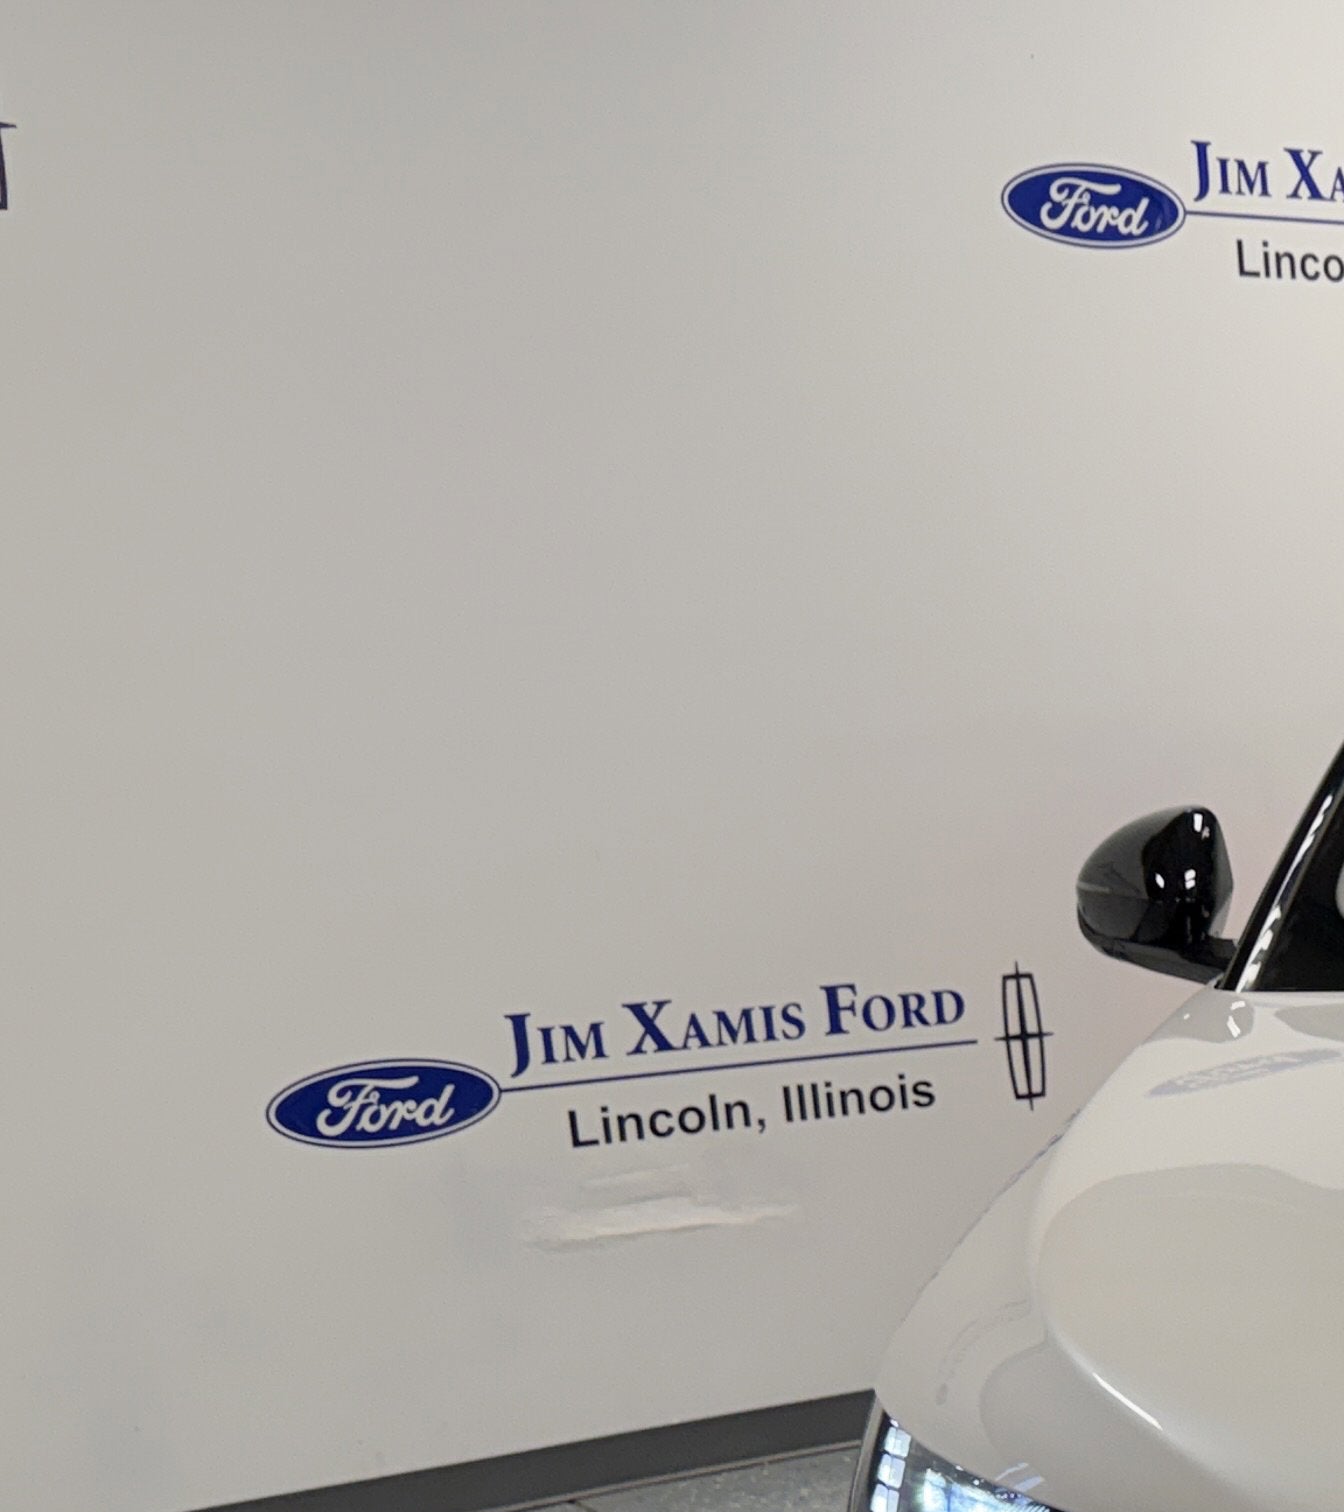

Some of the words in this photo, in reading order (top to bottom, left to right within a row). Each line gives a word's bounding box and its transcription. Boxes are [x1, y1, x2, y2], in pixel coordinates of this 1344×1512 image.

[1191, 140, 1271, 203] JIM
[1039, 176, 1149, 238] Ford
[503, 1011, 605, 1078] JIM
[621, 998, 807, 1055] XAMIS
[819, 982, 966, 1037] FORD
[315, 1073, 456, 1138] Ford
[566, 1092, 768, 1149] Lincoln,
[782, 1073, 937, 1126] Illinois
